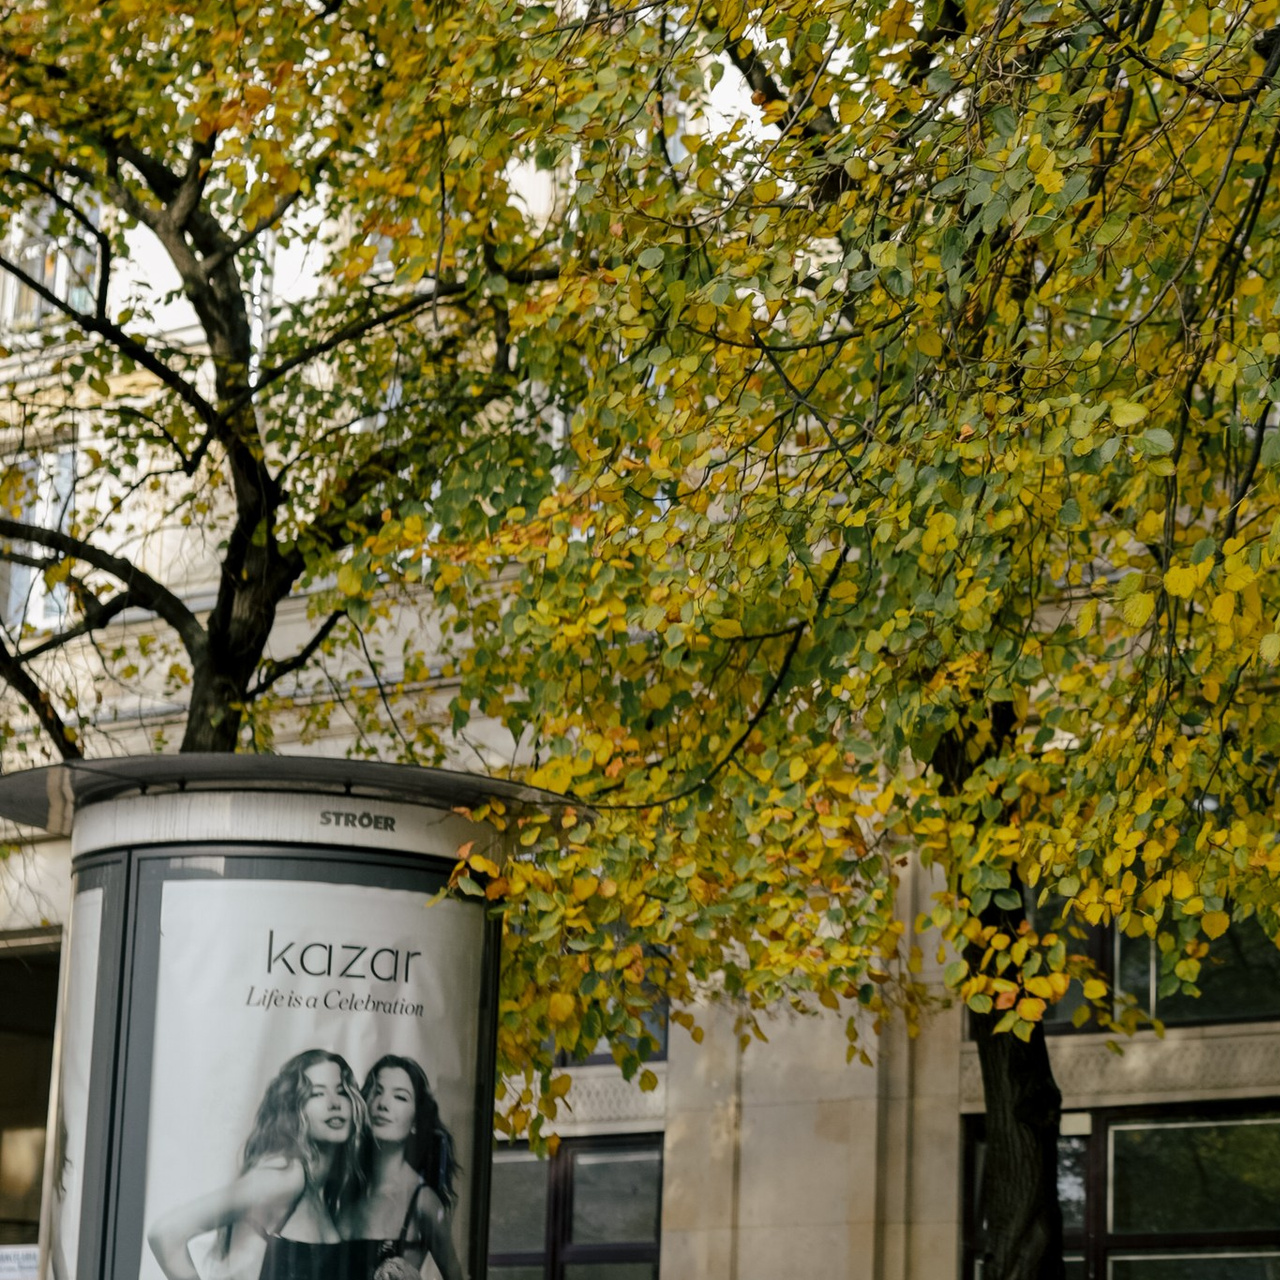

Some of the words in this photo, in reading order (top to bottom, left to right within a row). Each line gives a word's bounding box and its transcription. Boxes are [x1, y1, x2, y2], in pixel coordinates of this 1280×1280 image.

[320, 811, 396, 831] STRÖER
[266, 930, 422, 983] kazar
[246, 986, 284, 1010] Life
[287, 990, 302, 1007] is
[305, 996, 318, 1009] a
[323, 988, 425, 1018] Celebration
